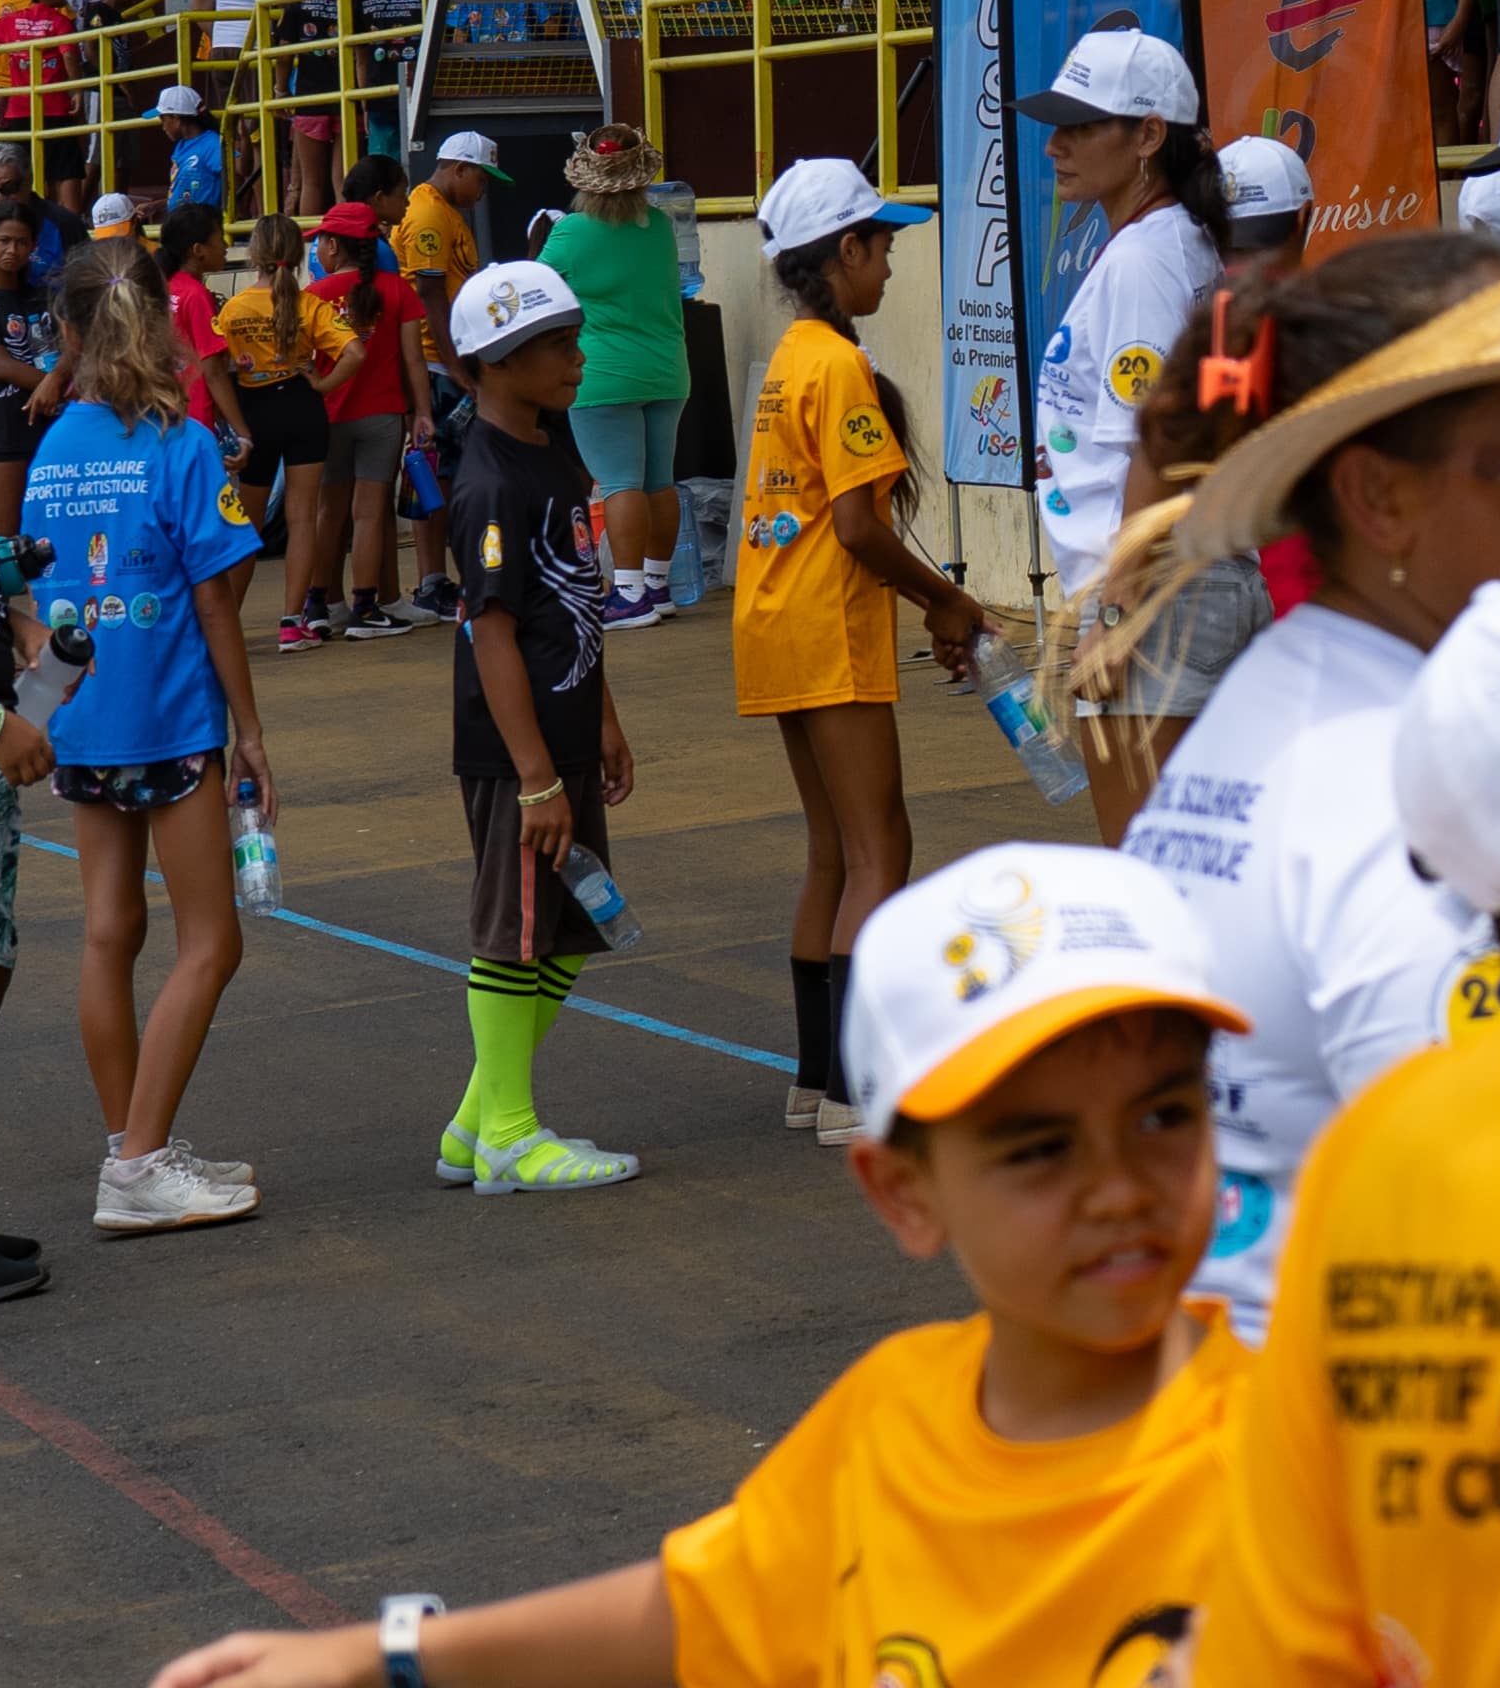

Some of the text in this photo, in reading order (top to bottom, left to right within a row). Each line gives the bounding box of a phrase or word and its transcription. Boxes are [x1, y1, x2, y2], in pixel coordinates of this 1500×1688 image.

[959, 299, 992, 318] Union
[947, 324, 963, 342] de
[952, 349, 1017, 369] du Premier
[1119, 355, 1149, 376] 20
[847, 414, 871, 435] 20
[862, 428, 883, 446] 24
[30, 460, 147, 483] FESTIVAL SCOLAIRE
[23, 479, 149, 502] SPORTIF ARTISTIQUE
[45, 498, 120, 518] ET CULTUREL
